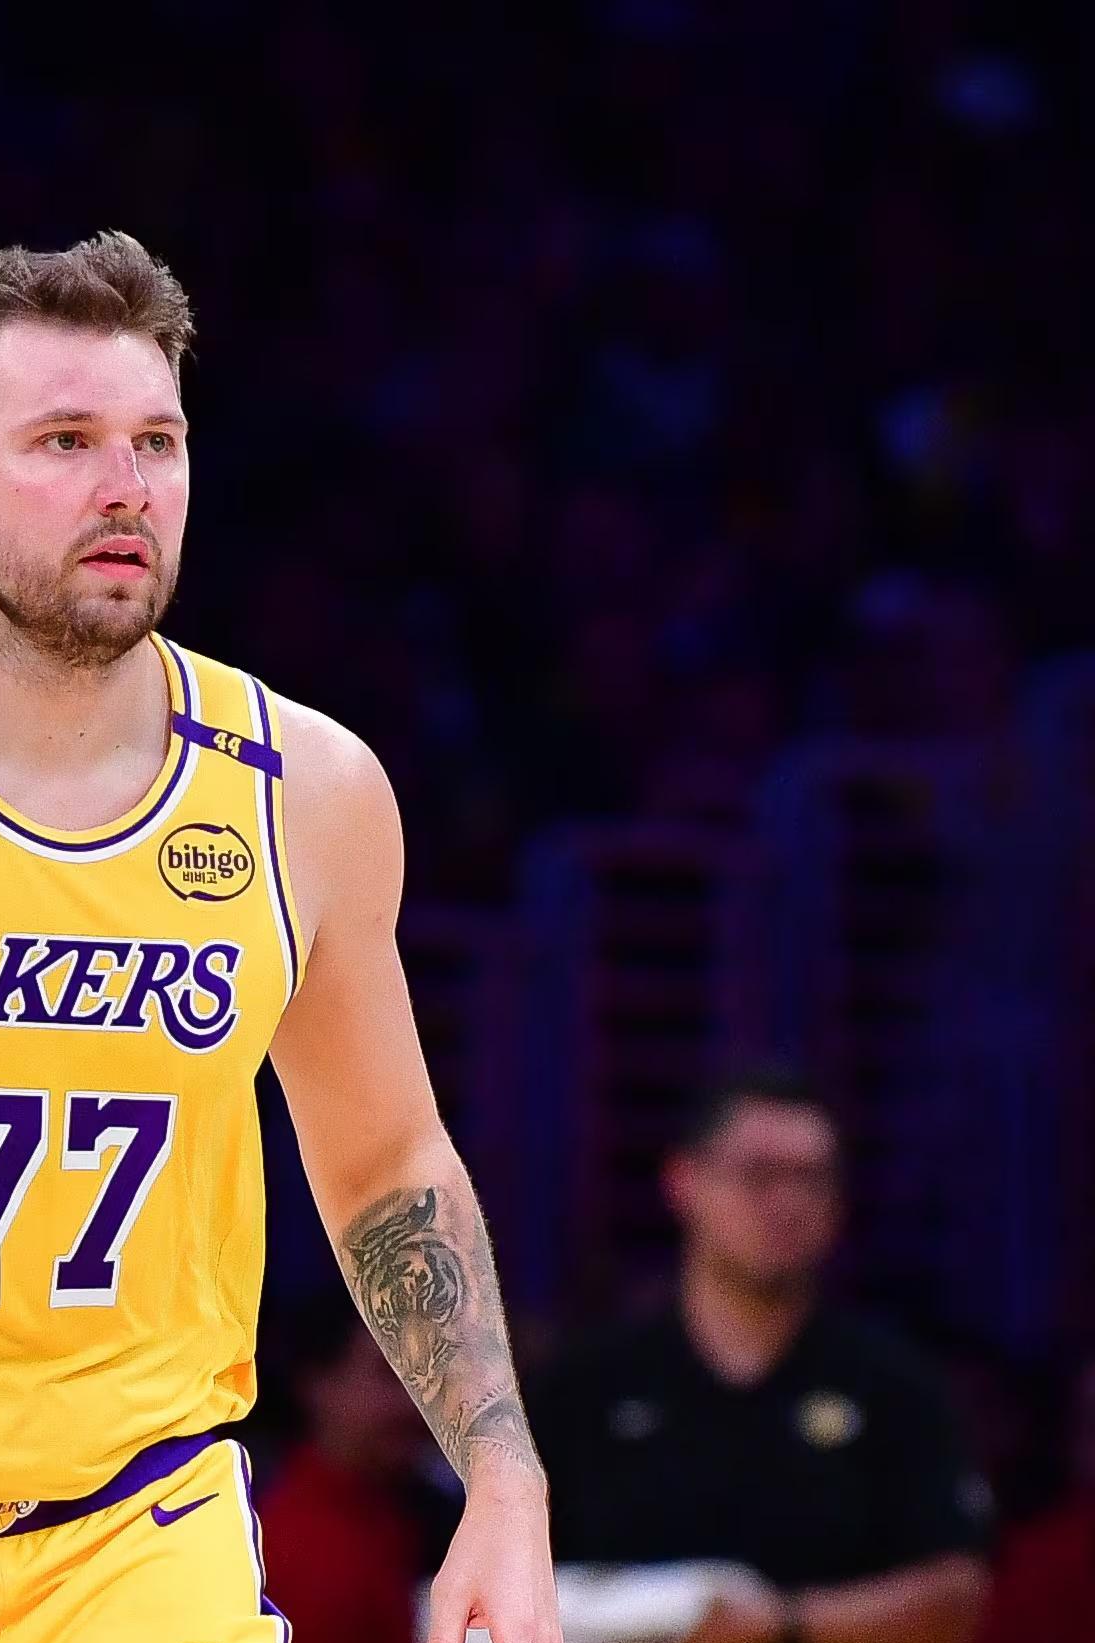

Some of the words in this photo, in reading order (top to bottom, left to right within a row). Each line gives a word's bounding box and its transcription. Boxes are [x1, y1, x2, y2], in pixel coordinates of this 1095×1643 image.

[213, 732, 241, 757] 44
[167, 843, 248, 879] bibigo
[182, 870, 217, 884] 비비고
